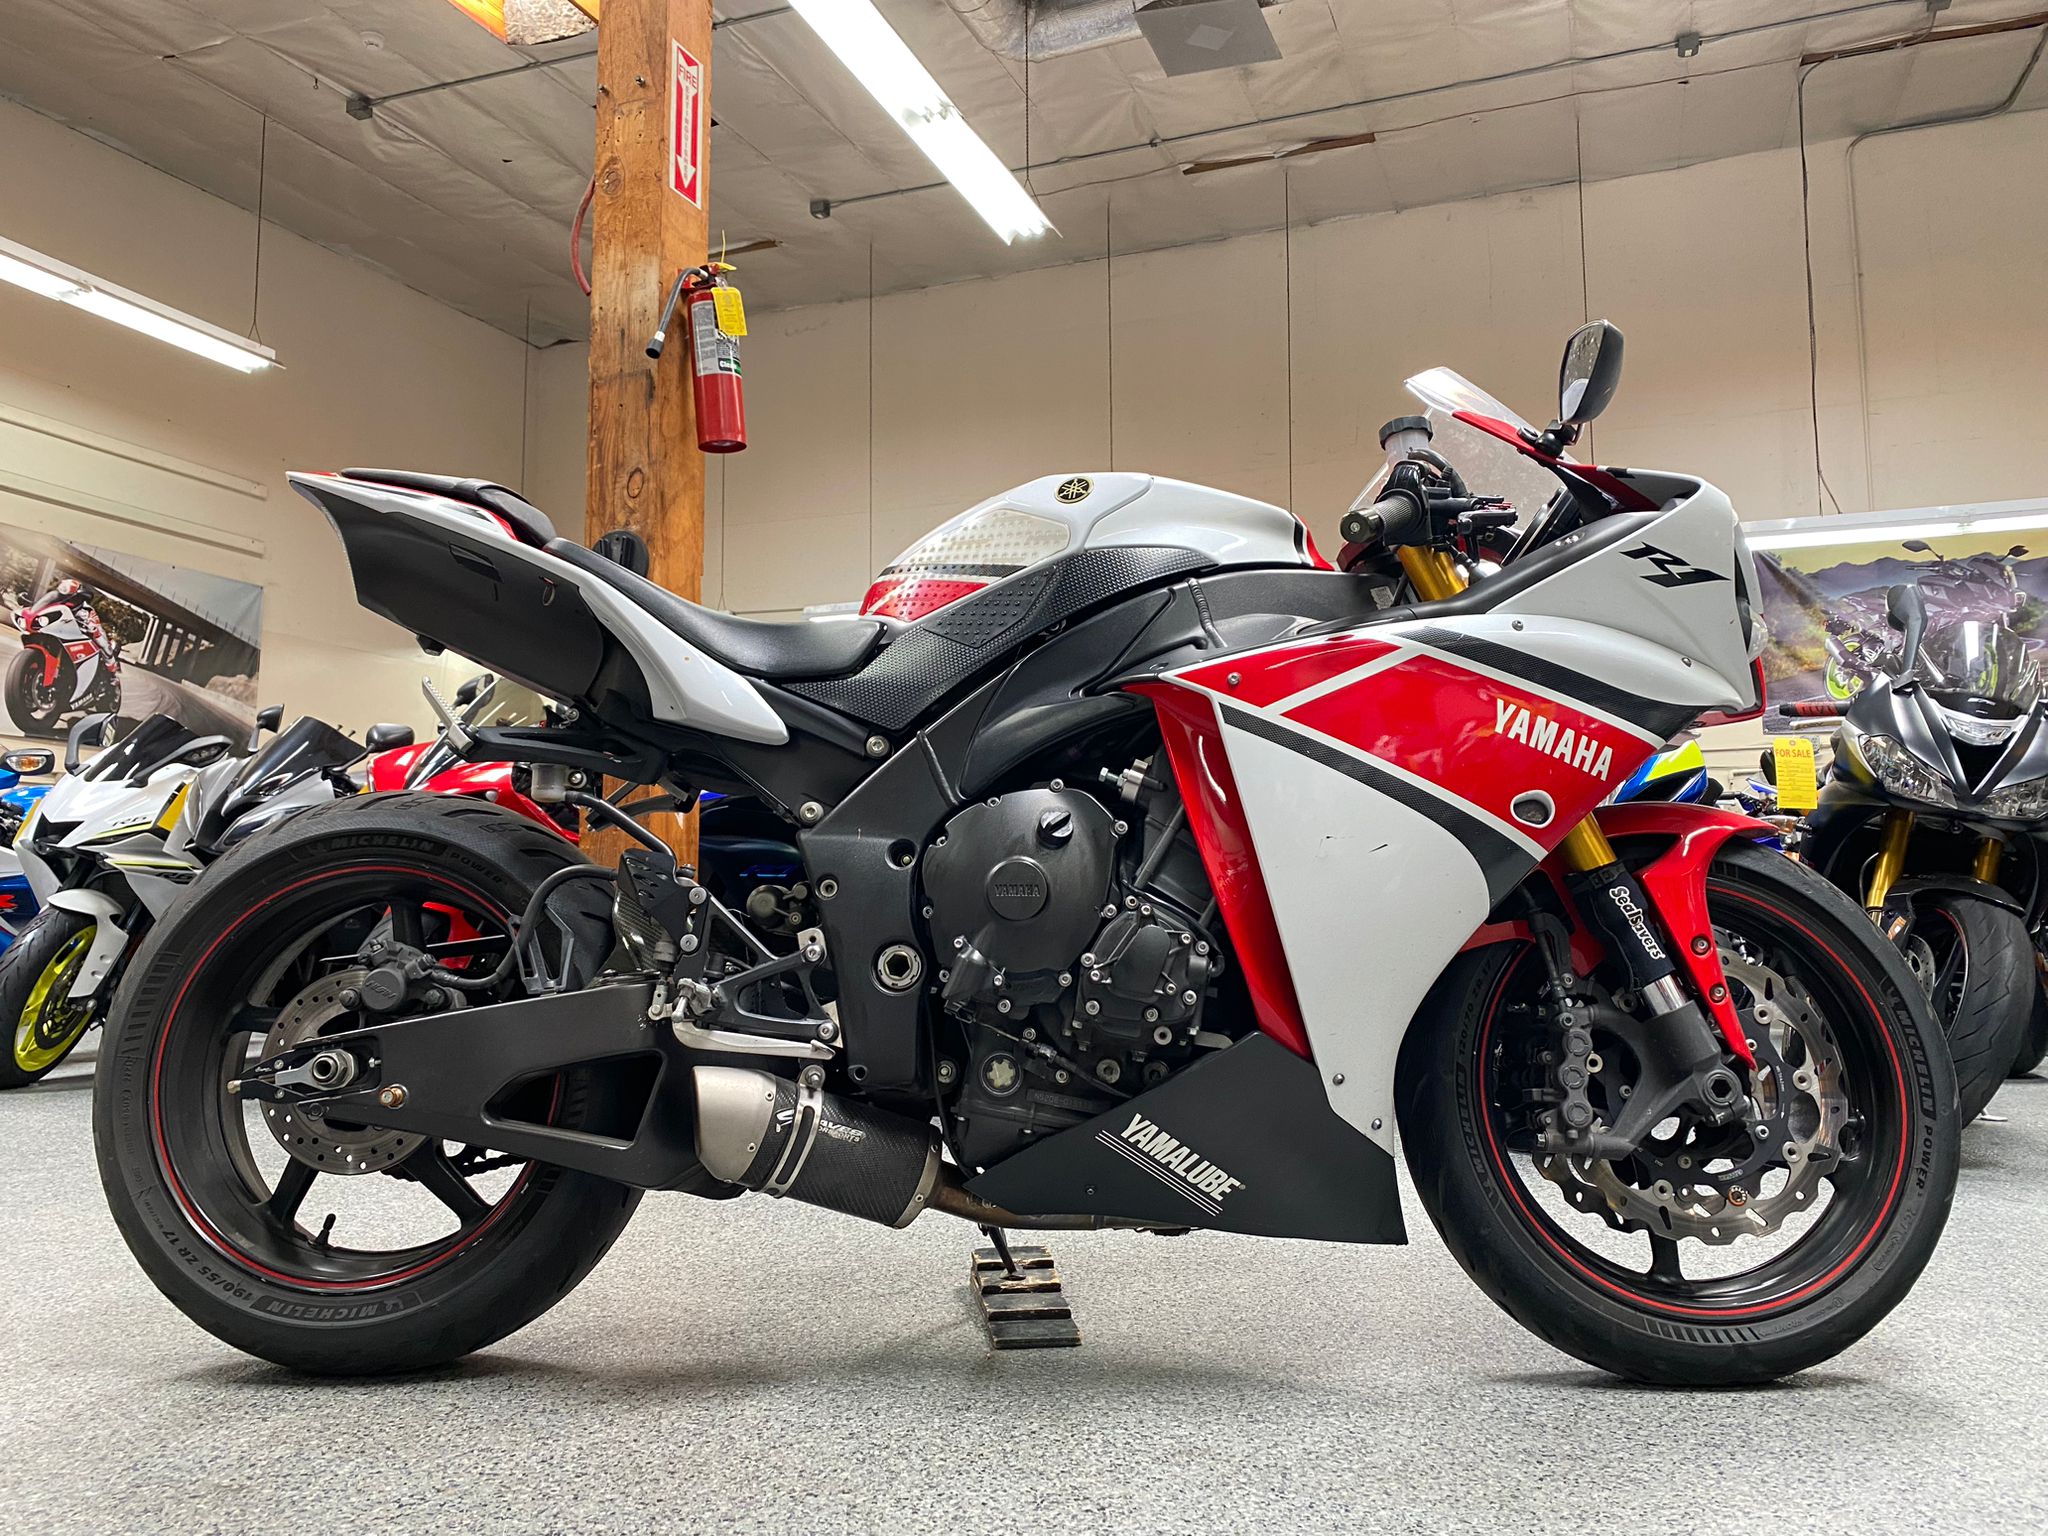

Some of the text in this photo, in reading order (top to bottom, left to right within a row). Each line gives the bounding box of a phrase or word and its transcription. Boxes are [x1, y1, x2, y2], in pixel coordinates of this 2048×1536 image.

[677, 63, 698, 89] FIRE
[1494, 698, 1613, 782] YAMAHA
[1776, 748, 1811, 758] FOR SALE
[330, 835, 434, 851] MICHELIN
[994, 883, 1040, 898] YAMAHA
[1609, 886, 1665, 959] SealSavers
[1896, 1009, 1935, 1115] MICHELIN
[1120, 1112, 1242, 1202] YAMALUBE
[161, 1229, 252, 1300] 190/55 ZR 17
[267, 1300, 378, 1320] MICHELIN
